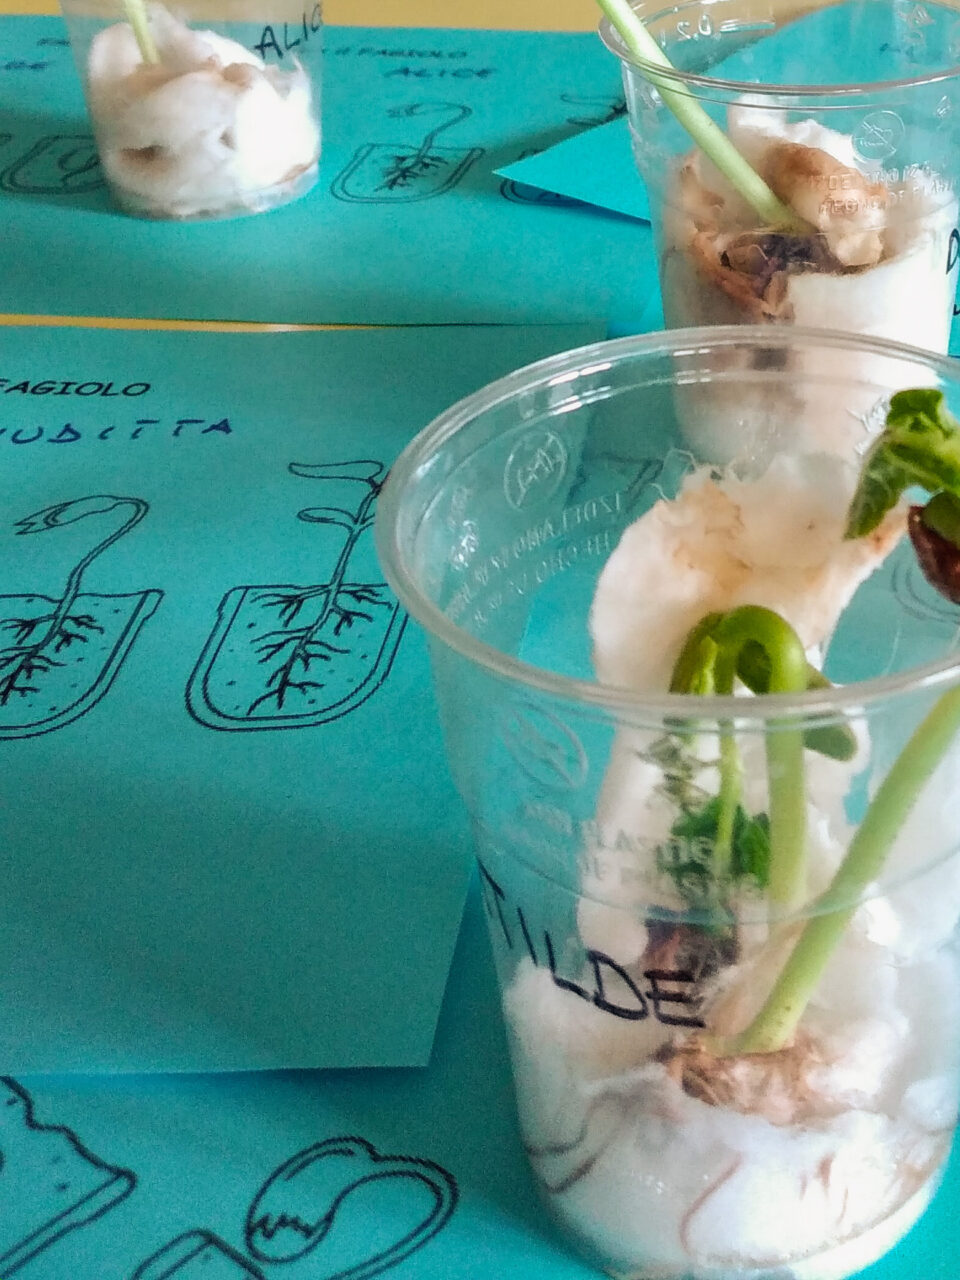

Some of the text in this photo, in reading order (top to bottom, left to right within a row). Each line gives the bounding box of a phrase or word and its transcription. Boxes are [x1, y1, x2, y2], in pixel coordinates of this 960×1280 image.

[254, 2, 324, 61] ALIC
[0, 418, 233, 445] UDITTA
[476, 854, 707, 1029] TILDE
